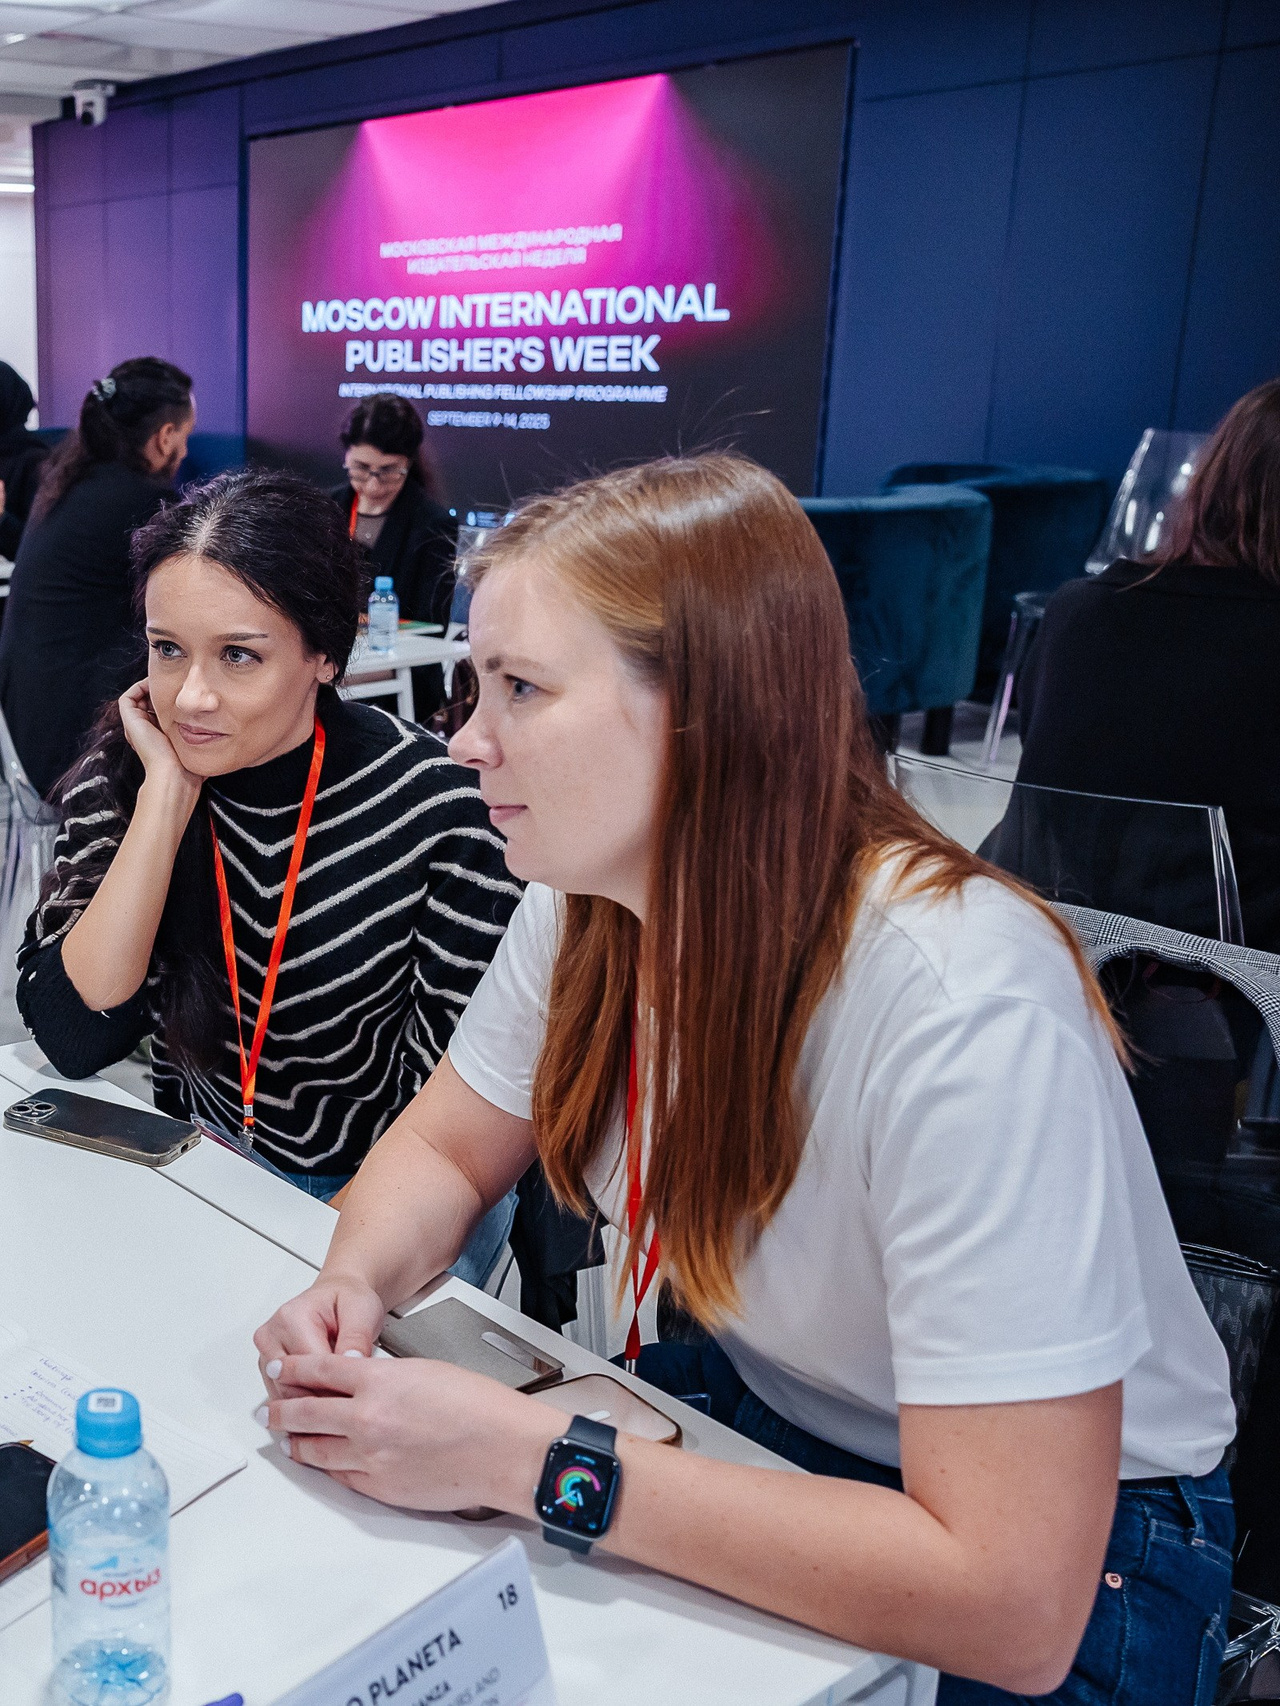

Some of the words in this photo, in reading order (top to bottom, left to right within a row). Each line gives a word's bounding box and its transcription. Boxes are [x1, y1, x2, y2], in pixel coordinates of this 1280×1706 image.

[301, 296, 436, 333] MOSCOW
[440, 284, 730, 327] INTERNATIONAL
[345, 336, 545, 373] PUBLISHER'S
[550, 334, 662, 373] WEEK
[494, 384, 575, 401] FELLOWSHIP
[575, 385, 668, 403] PROGRAMME
[497, 1583, 519, 1611] 18
[368, 1627, 463, 1706] PLANETA
